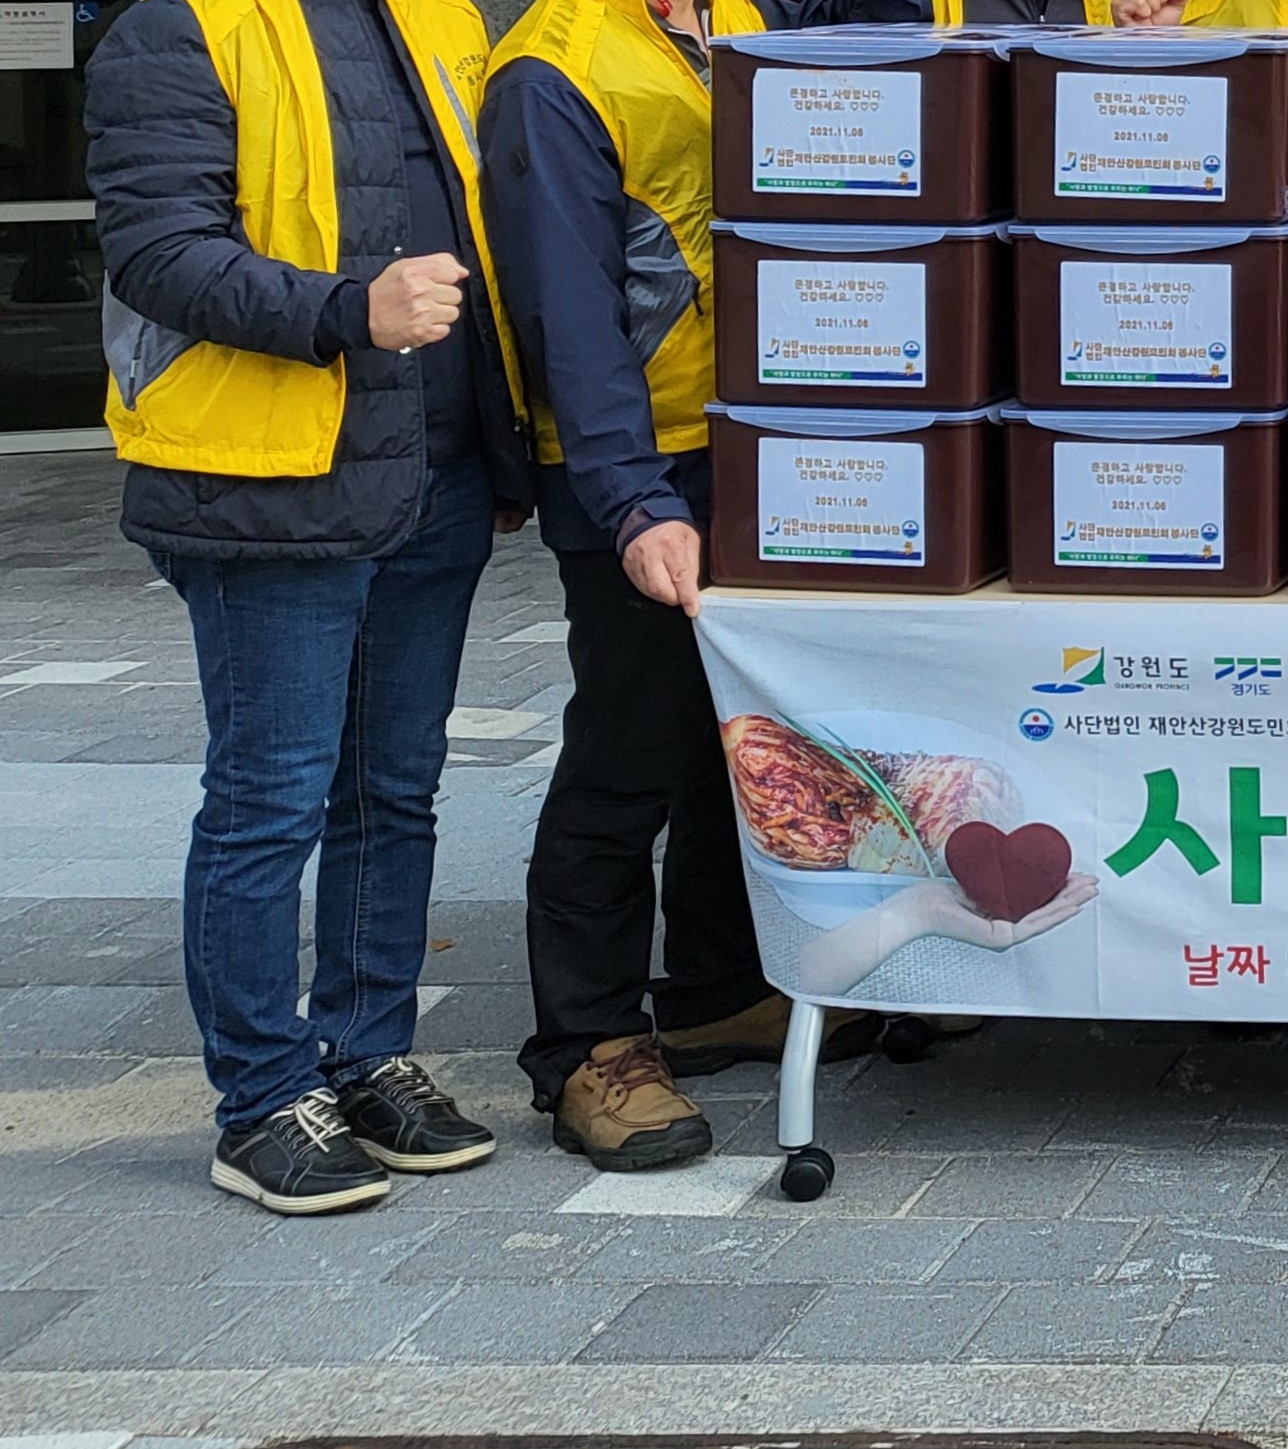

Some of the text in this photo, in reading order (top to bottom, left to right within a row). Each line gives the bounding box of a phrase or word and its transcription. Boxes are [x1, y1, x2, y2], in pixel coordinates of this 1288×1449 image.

[1113, 656, 1190, 680] 강원도
[1230, 683, 1272, 696] 경기도
[1064, 715, 1141, 736] 사단법인
[1183, 943, 1271, 988] 날짜
